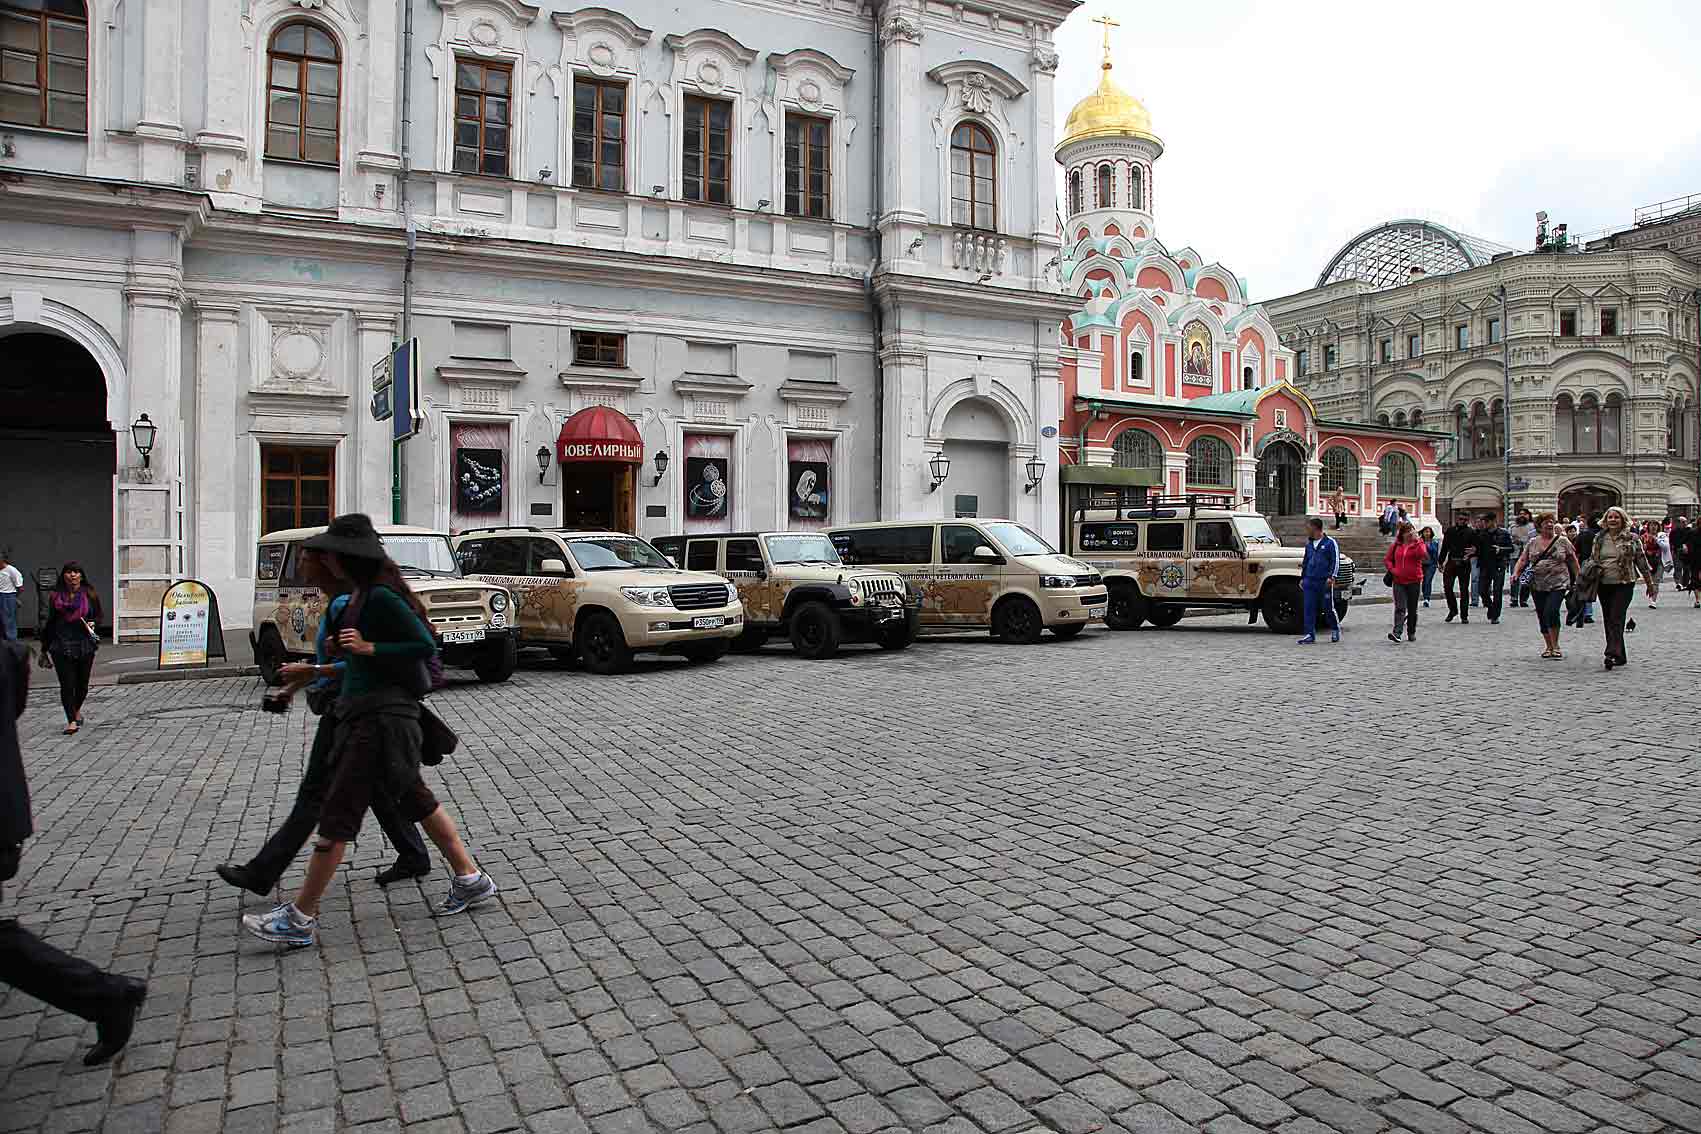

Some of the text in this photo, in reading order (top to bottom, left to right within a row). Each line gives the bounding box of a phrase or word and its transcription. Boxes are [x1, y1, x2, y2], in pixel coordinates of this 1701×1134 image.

[564, 443, 641, 458] ЮВЕЛИРНЫЙ
[1137, 551, 1184, 559] INTERNATIONAL
[1192, 551, 1220, 559] VETERAN
